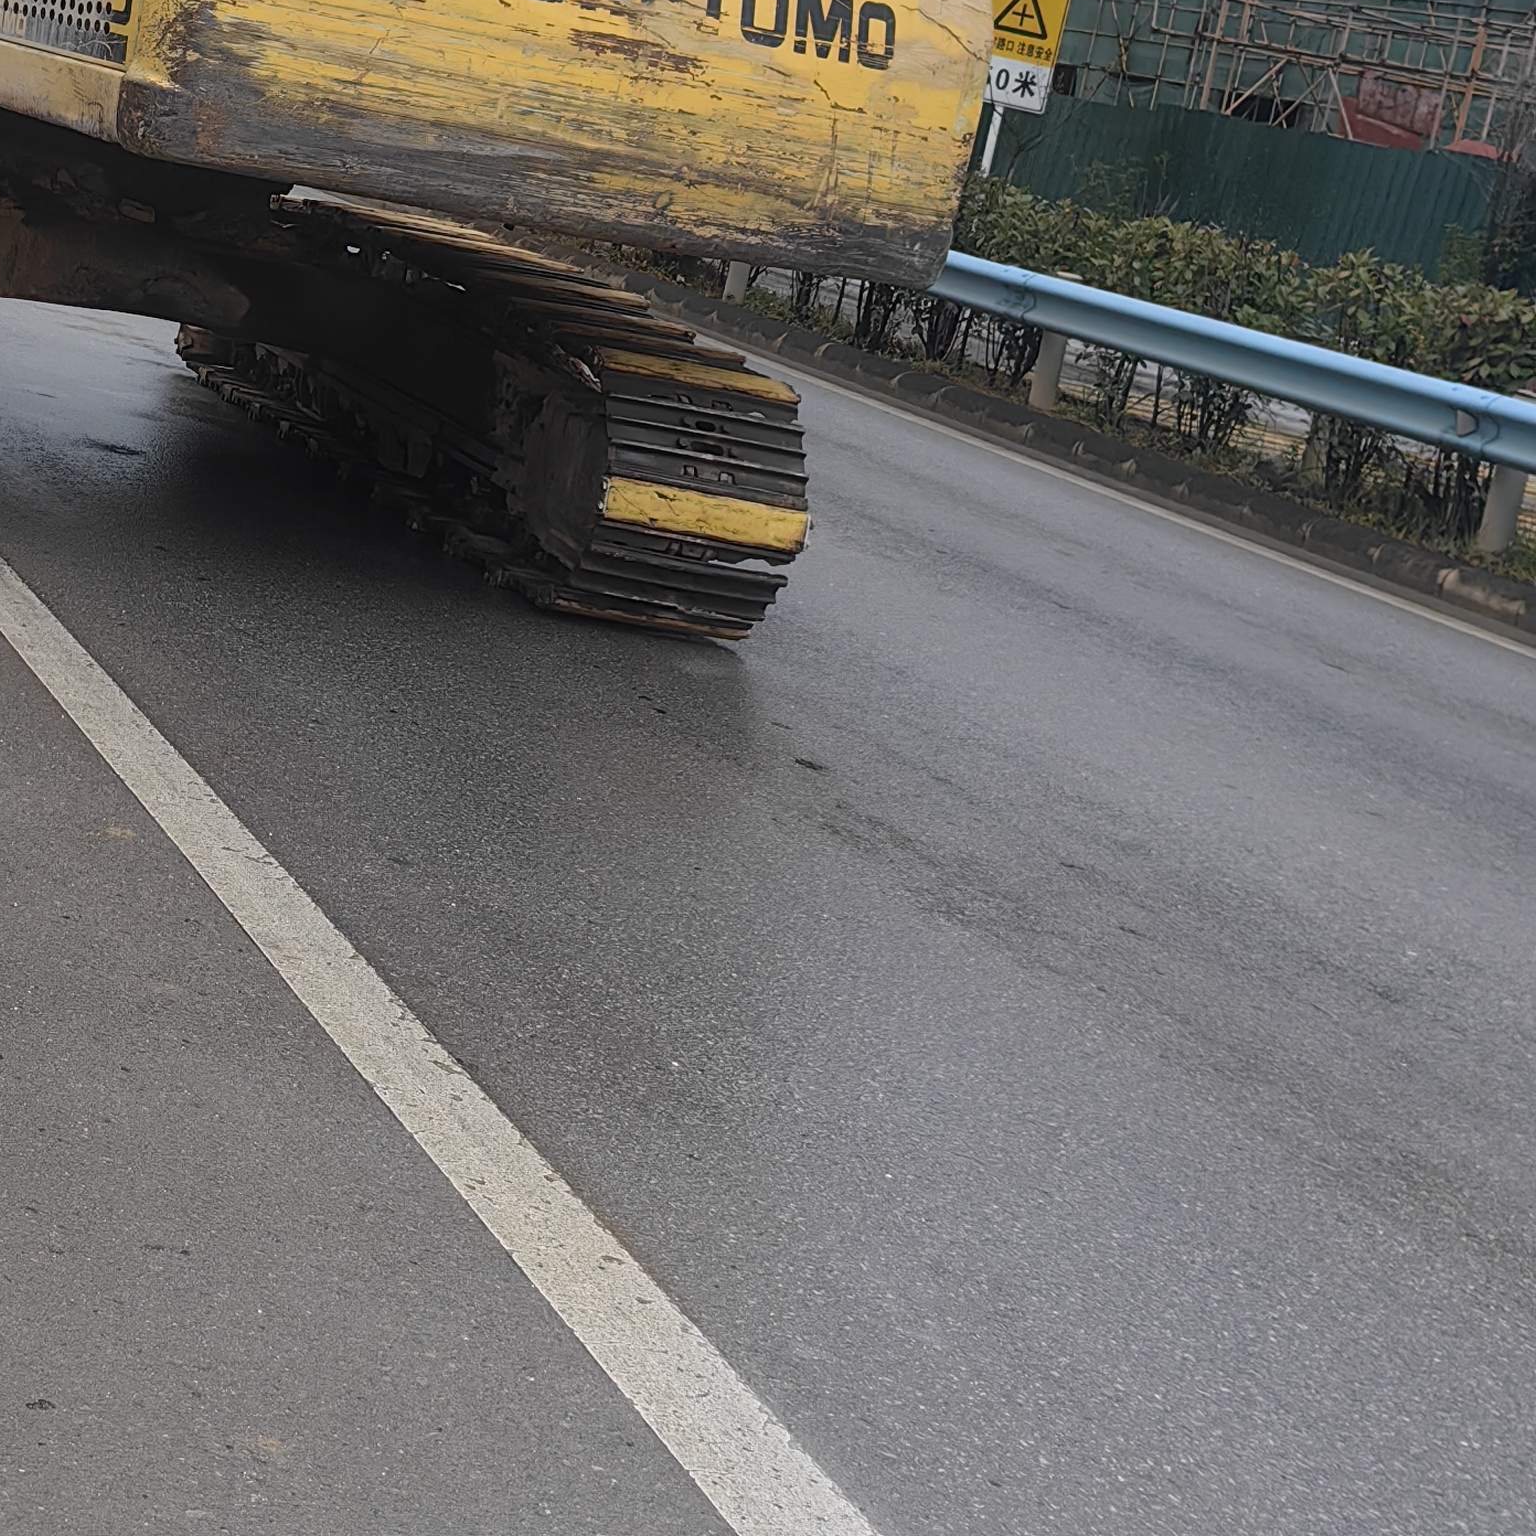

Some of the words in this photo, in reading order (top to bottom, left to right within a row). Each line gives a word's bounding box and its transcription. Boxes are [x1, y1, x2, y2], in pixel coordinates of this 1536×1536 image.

[994, 36, 1014, 52] 路口
[1017, 41, 1052, 61] 注意安全
[990, 65, 1037, 98] 0米
